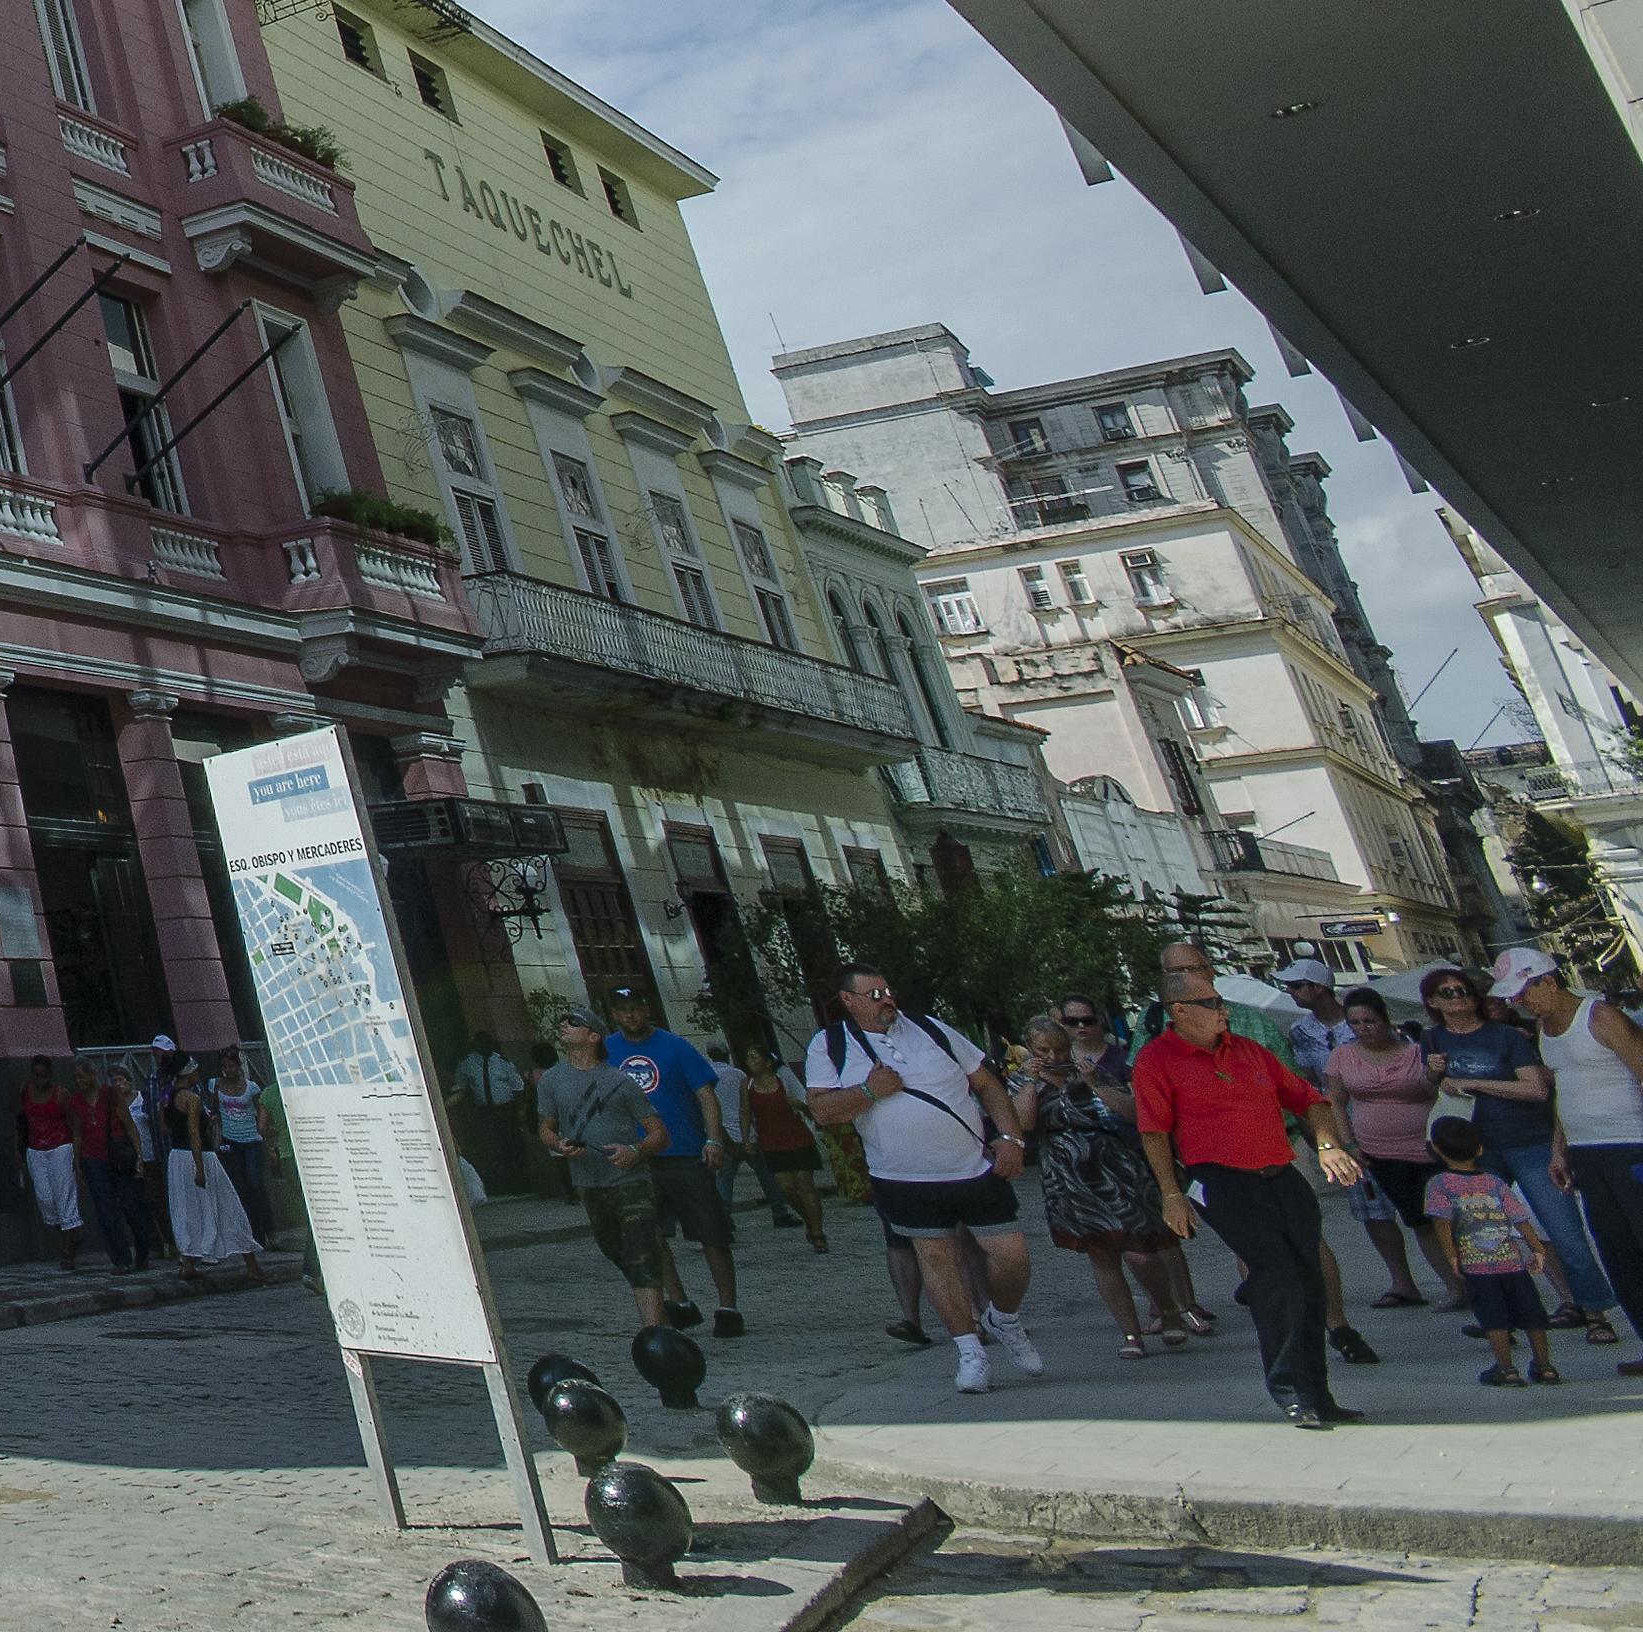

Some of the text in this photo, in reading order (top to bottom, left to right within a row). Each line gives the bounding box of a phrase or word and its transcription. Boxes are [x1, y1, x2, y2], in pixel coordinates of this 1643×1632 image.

[424, 148, 632, 299] TAQUECHEL
[253, 773, 321, 803] you are here
[229, 837, 363, 872] ESQ. OBISPO Y MERCADERES
